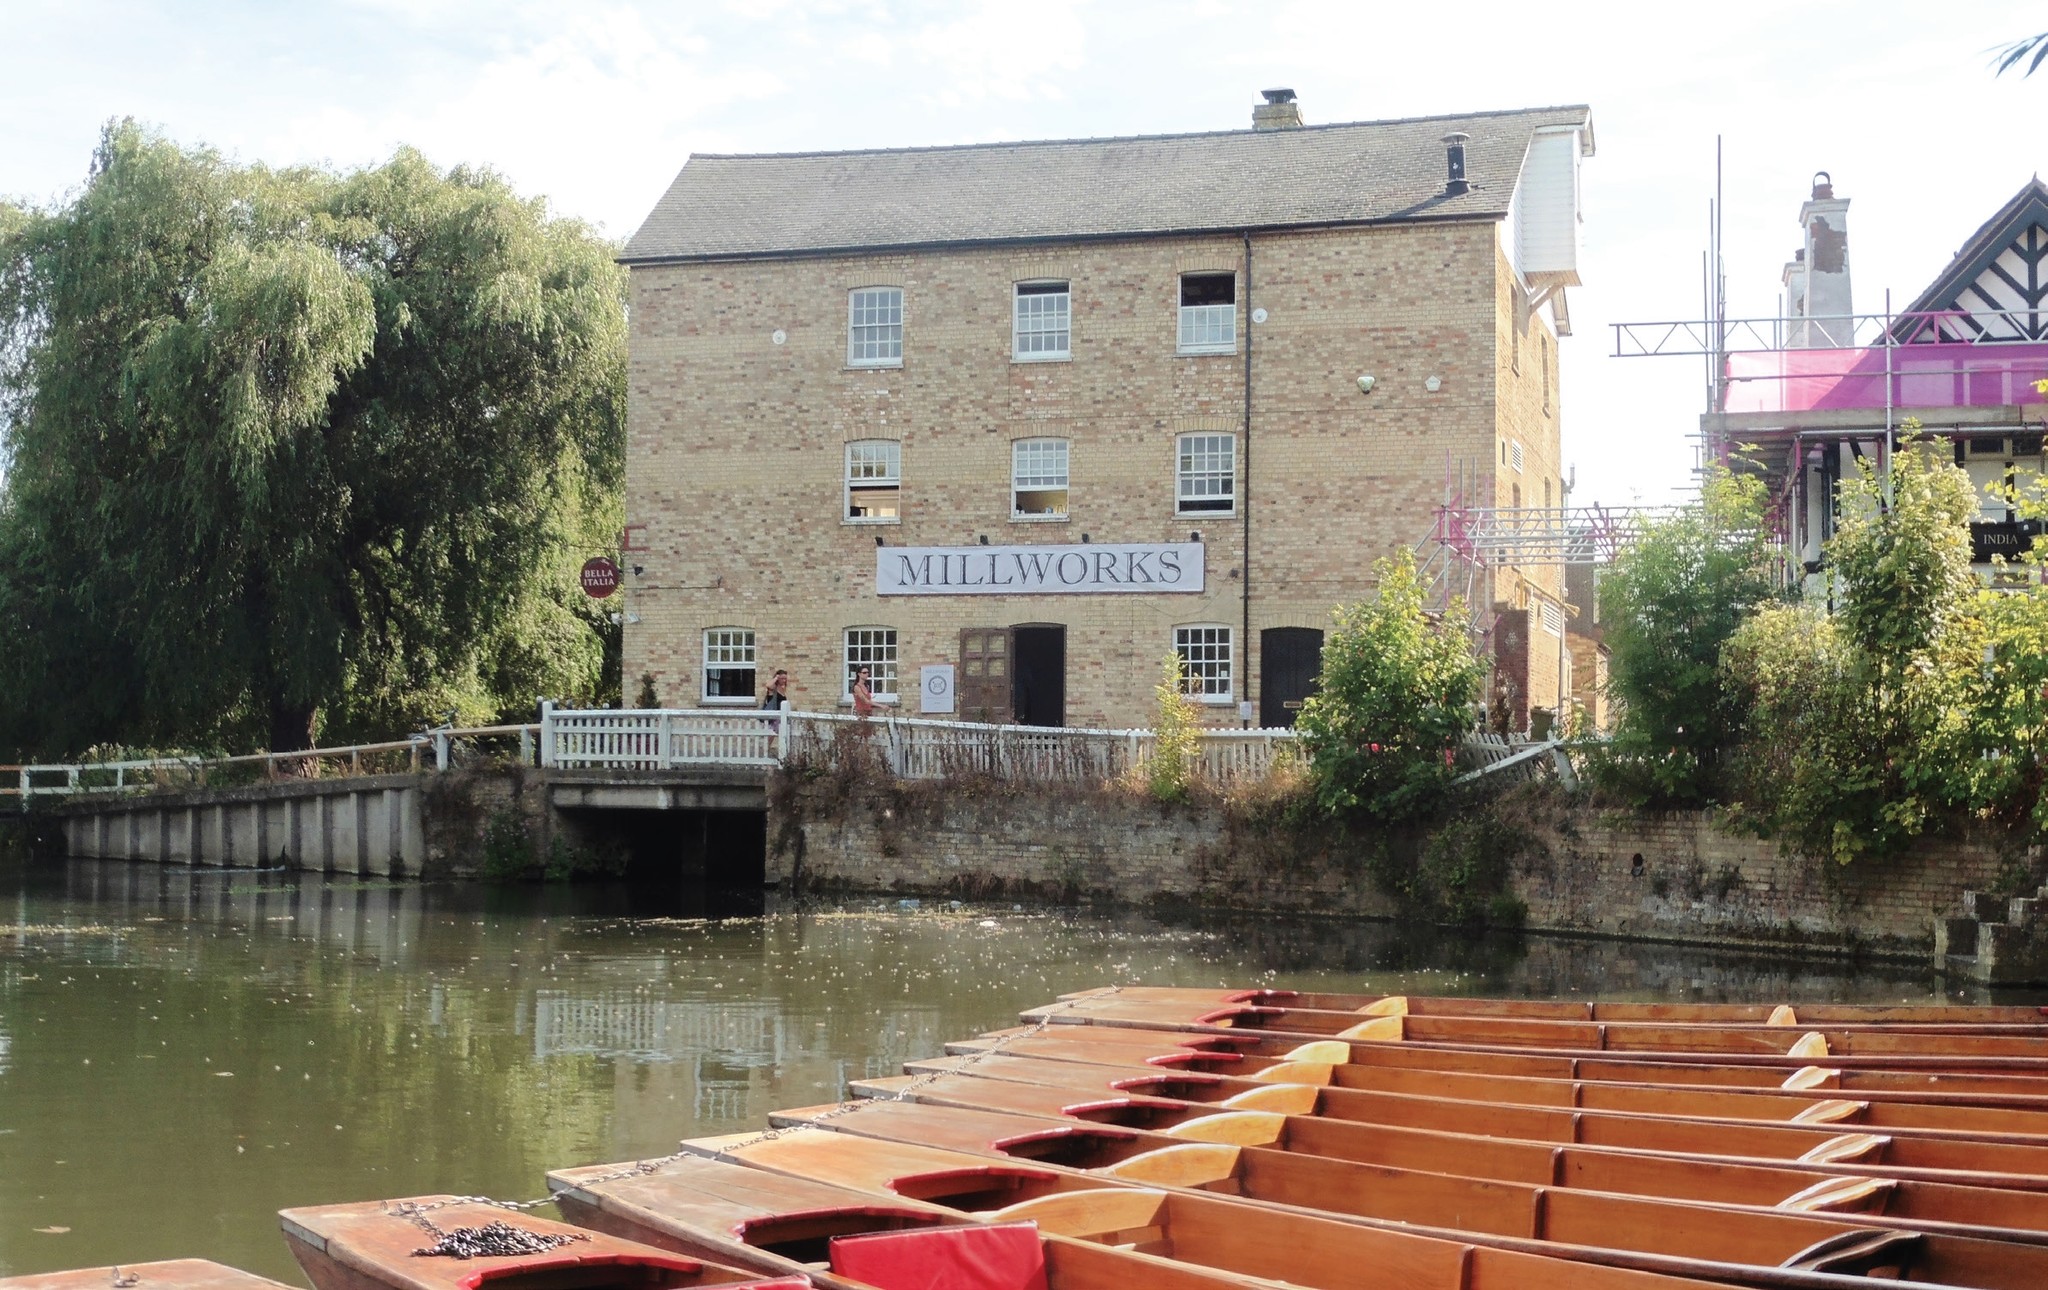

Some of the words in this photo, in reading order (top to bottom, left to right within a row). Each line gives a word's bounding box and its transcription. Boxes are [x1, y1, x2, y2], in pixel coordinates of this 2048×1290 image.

[1983, 534, 2018, 545] INDIA
[897, 550, 1182, 586] MILLWORKS
[584, 569, 614, 578] BELLA
[583, 578, 615, 586] ITALIA
